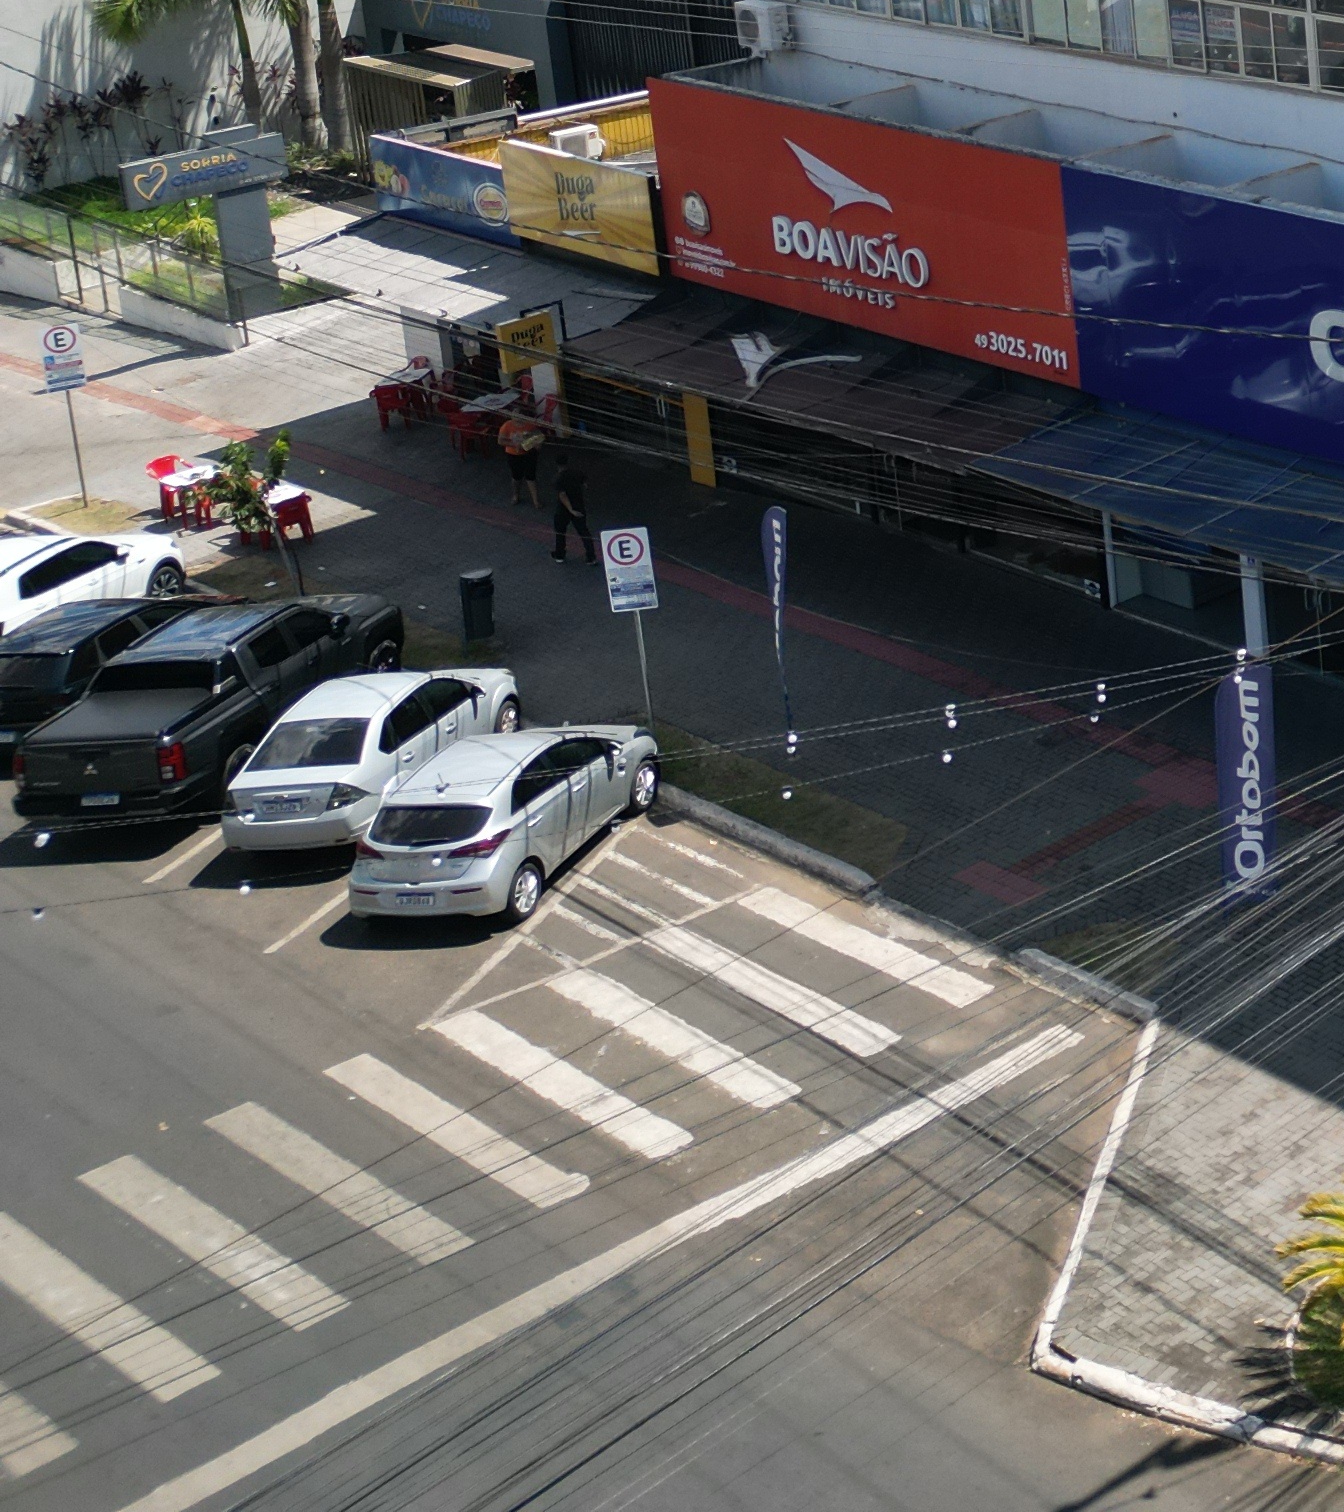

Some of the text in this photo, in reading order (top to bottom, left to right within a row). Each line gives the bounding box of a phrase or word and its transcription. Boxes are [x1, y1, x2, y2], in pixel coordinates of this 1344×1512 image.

[181, 152, 237, 173] SORRIA
[554, 171, 595, 202] Duga
[557, 198, 597, 222] Beer
[821, 276, 897, 310] IMÓVEIS
[53, 331, 67, 348] E
[515, 333, 546, 348] eer
[974, 331, 1069, 371] 49 3025.7011
[618, 539, 633, 559] E
[1234, 679, 1266, 880] Ortobom
